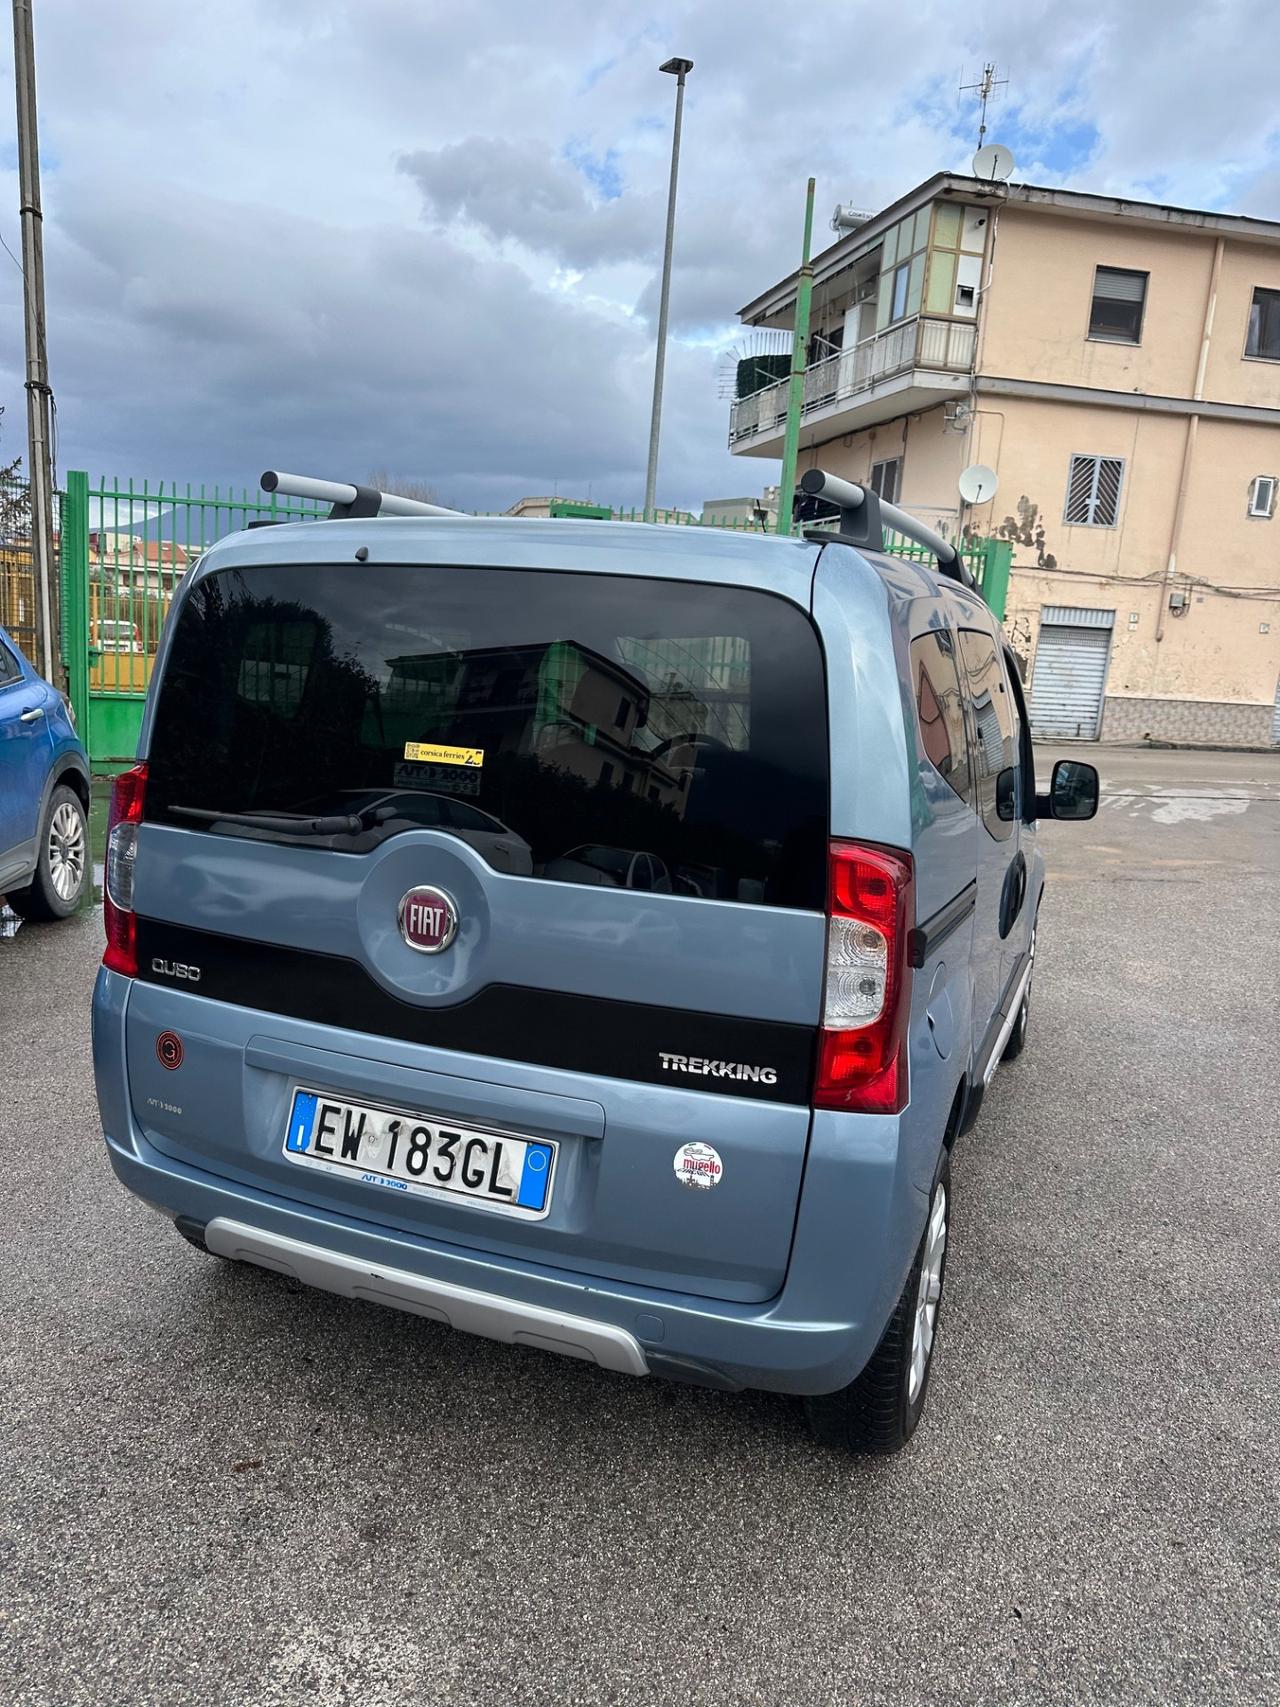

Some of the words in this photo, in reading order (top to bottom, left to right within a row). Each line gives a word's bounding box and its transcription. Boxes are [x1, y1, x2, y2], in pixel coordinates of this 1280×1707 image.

[420, 750, 443, 758] corsica
[443, 751, 465, 760] ferries
[409, 904, 444, 937] FIAT
[151, 958, 200, 982] QUBO
[658, 1052, 777, 1084] TREKKING
[314, 1104, 367, 1161] EW
[387, 1120, 513, 1196] 183GL
[683, 1158, 721, 1175] mugello
